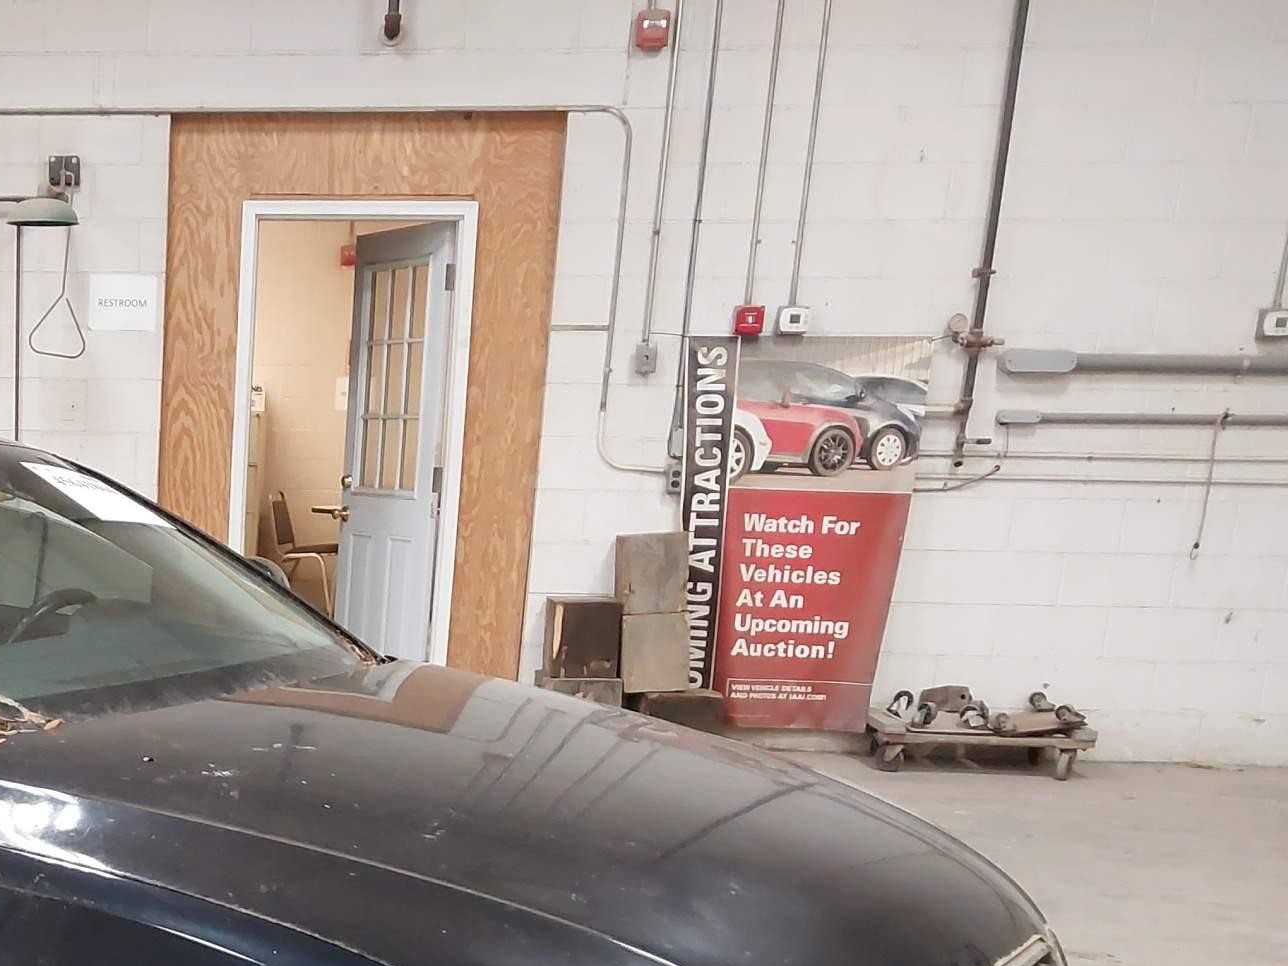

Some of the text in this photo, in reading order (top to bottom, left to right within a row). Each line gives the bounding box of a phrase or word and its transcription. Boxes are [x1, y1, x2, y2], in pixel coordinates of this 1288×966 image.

[97, 298, 148, 308] RESTROOM
[686, 345, 728, 689] OMING ATTRACTIONS
[743, 513, 861, 535] Watch For
[742, 538, 813, 559] These
[740, 563, 841, 585] Vehicles
[736, 588, 804, 609] At An
[734, 613, 850, 640] Upcoming
[730, 638, 836, 659] Auction!
